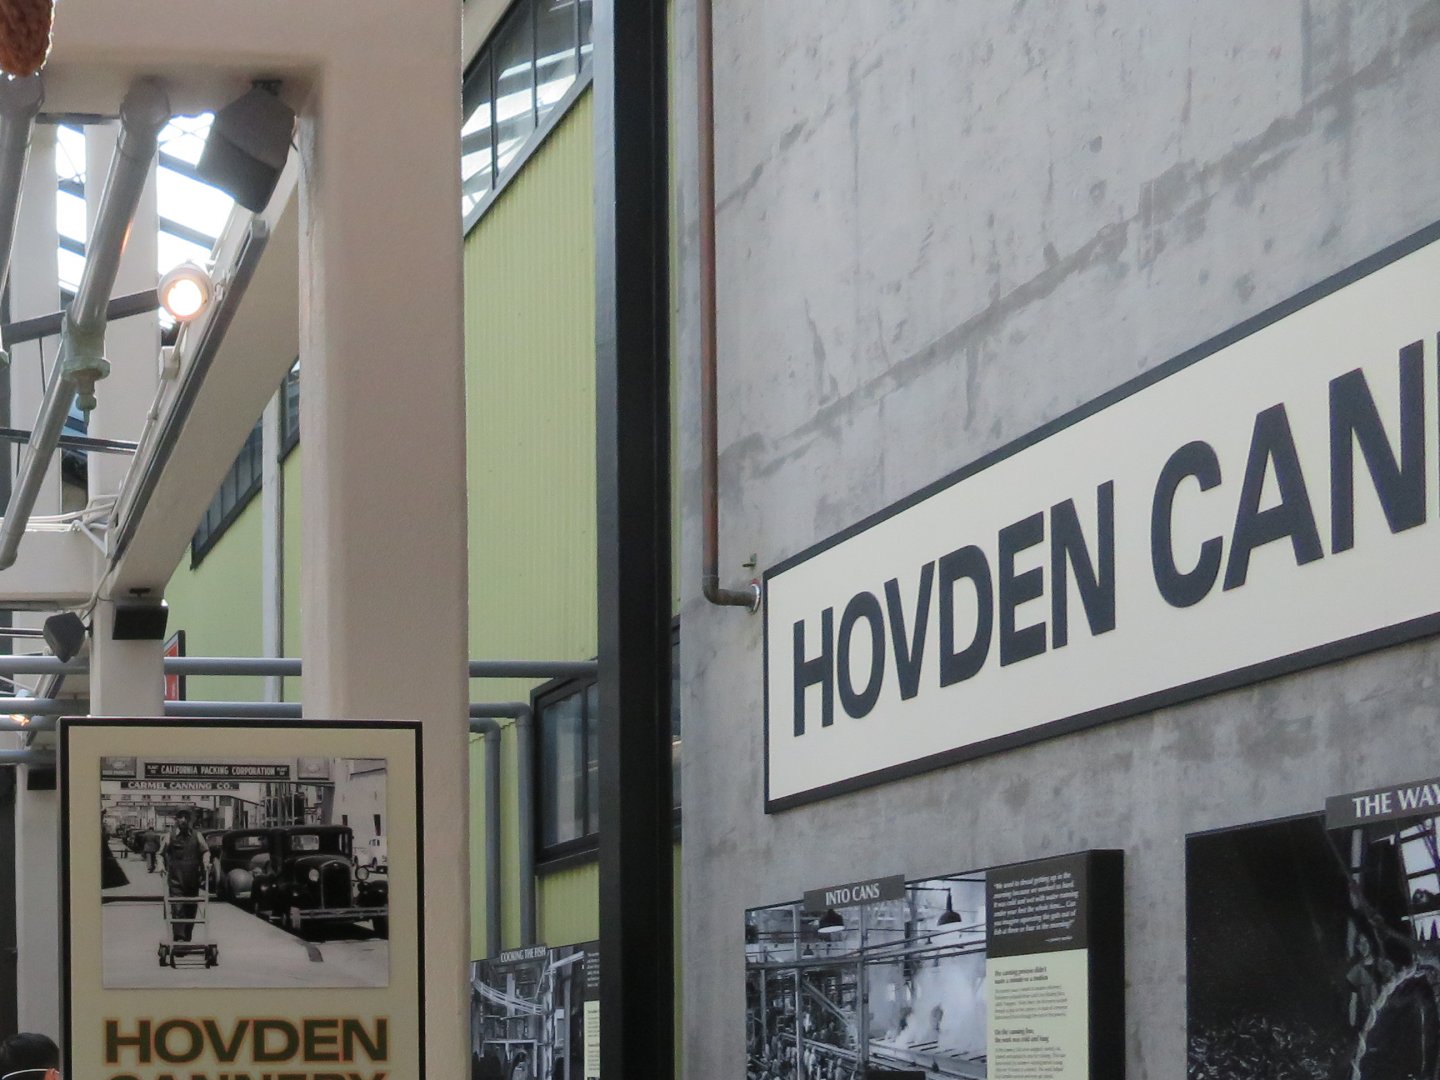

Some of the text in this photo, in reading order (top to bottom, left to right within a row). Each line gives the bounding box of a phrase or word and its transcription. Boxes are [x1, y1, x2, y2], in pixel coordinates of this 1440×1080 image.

[793, 331, 1440, 737] HOVDEN CAN
[231, 766, 275, 776] CORPORATION
[128, 781, 233, 790] CARMEL CANNING CO.
[1352, 792, 1392, 818] THE
[825, 883, 880, 906] INTO CANS
[104, 1017, 389, 1064] HOVDEN
